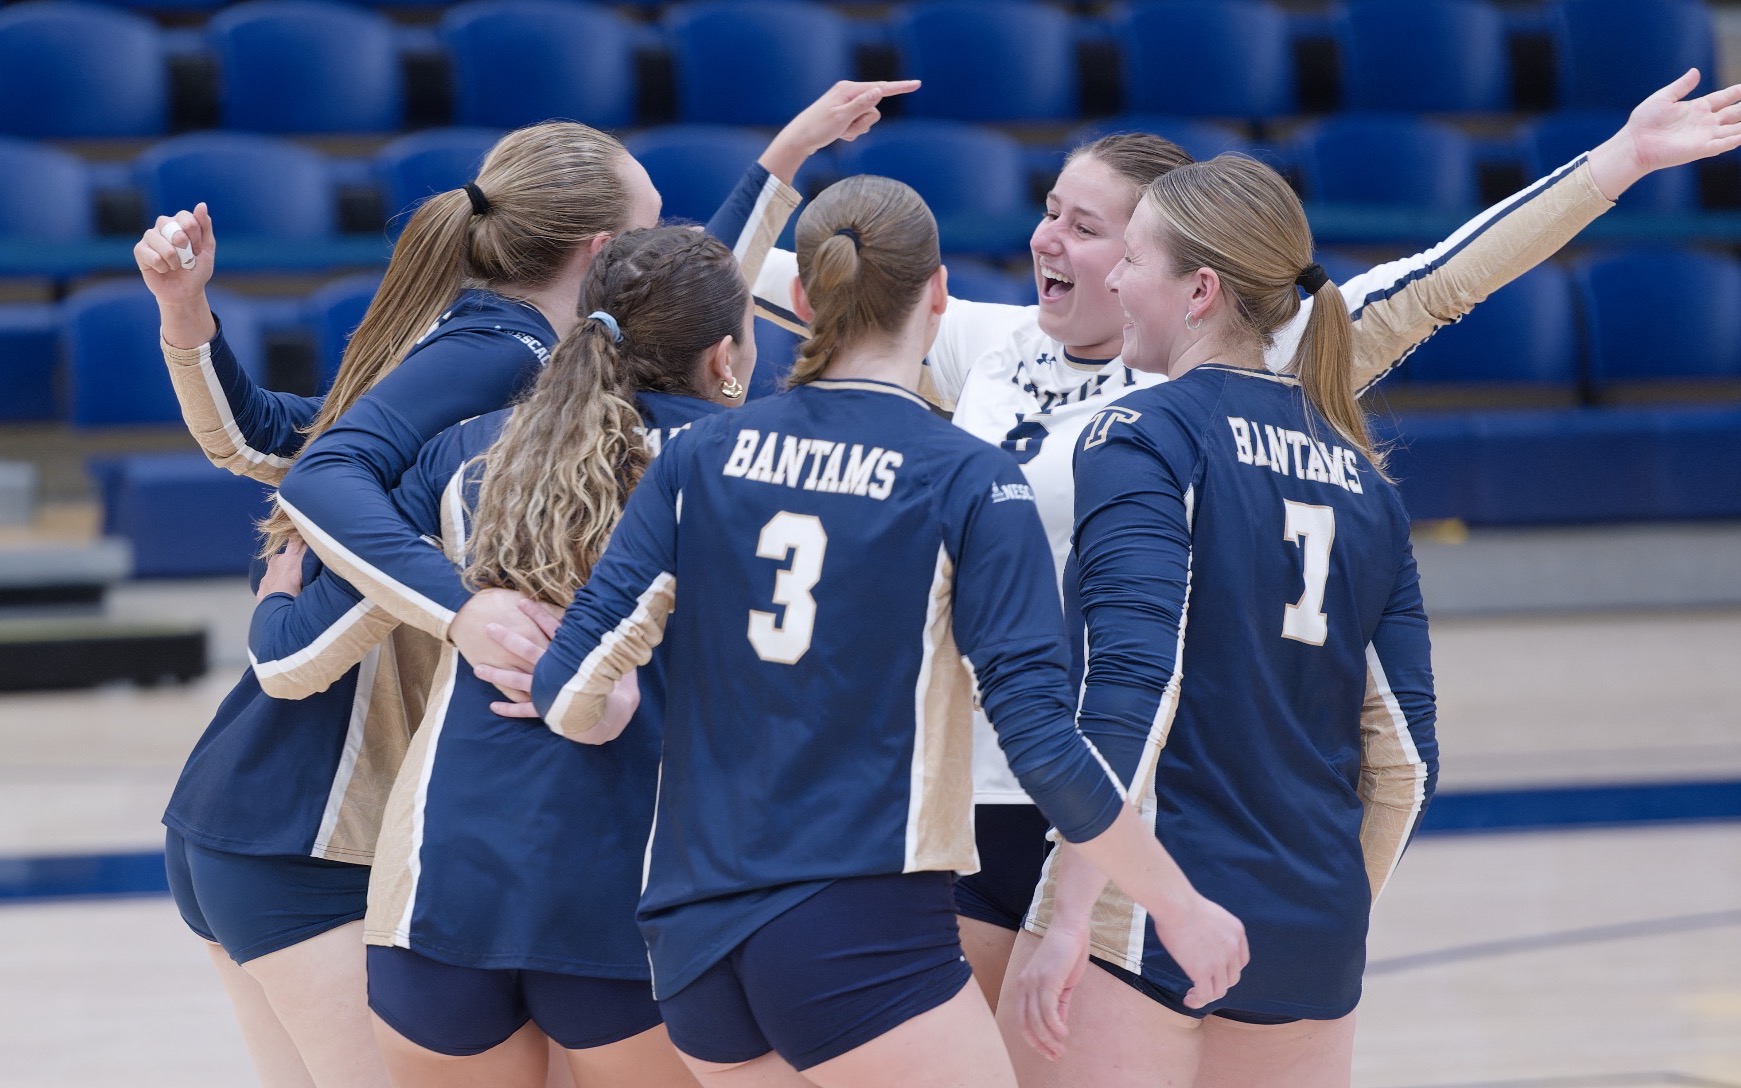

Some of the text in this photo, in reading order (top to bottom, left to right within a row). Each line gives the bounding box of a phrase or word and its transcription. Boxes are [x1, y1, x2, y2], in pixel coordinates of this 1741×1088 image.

[722, 429, 903, 500] BANTAMS
[1083, 405, 1142, 451] T
[1227, 416, 1363, 494] BANTAMS
[747, 510, 828, 665] 3
[1281, 498, 1335, 646] 7
